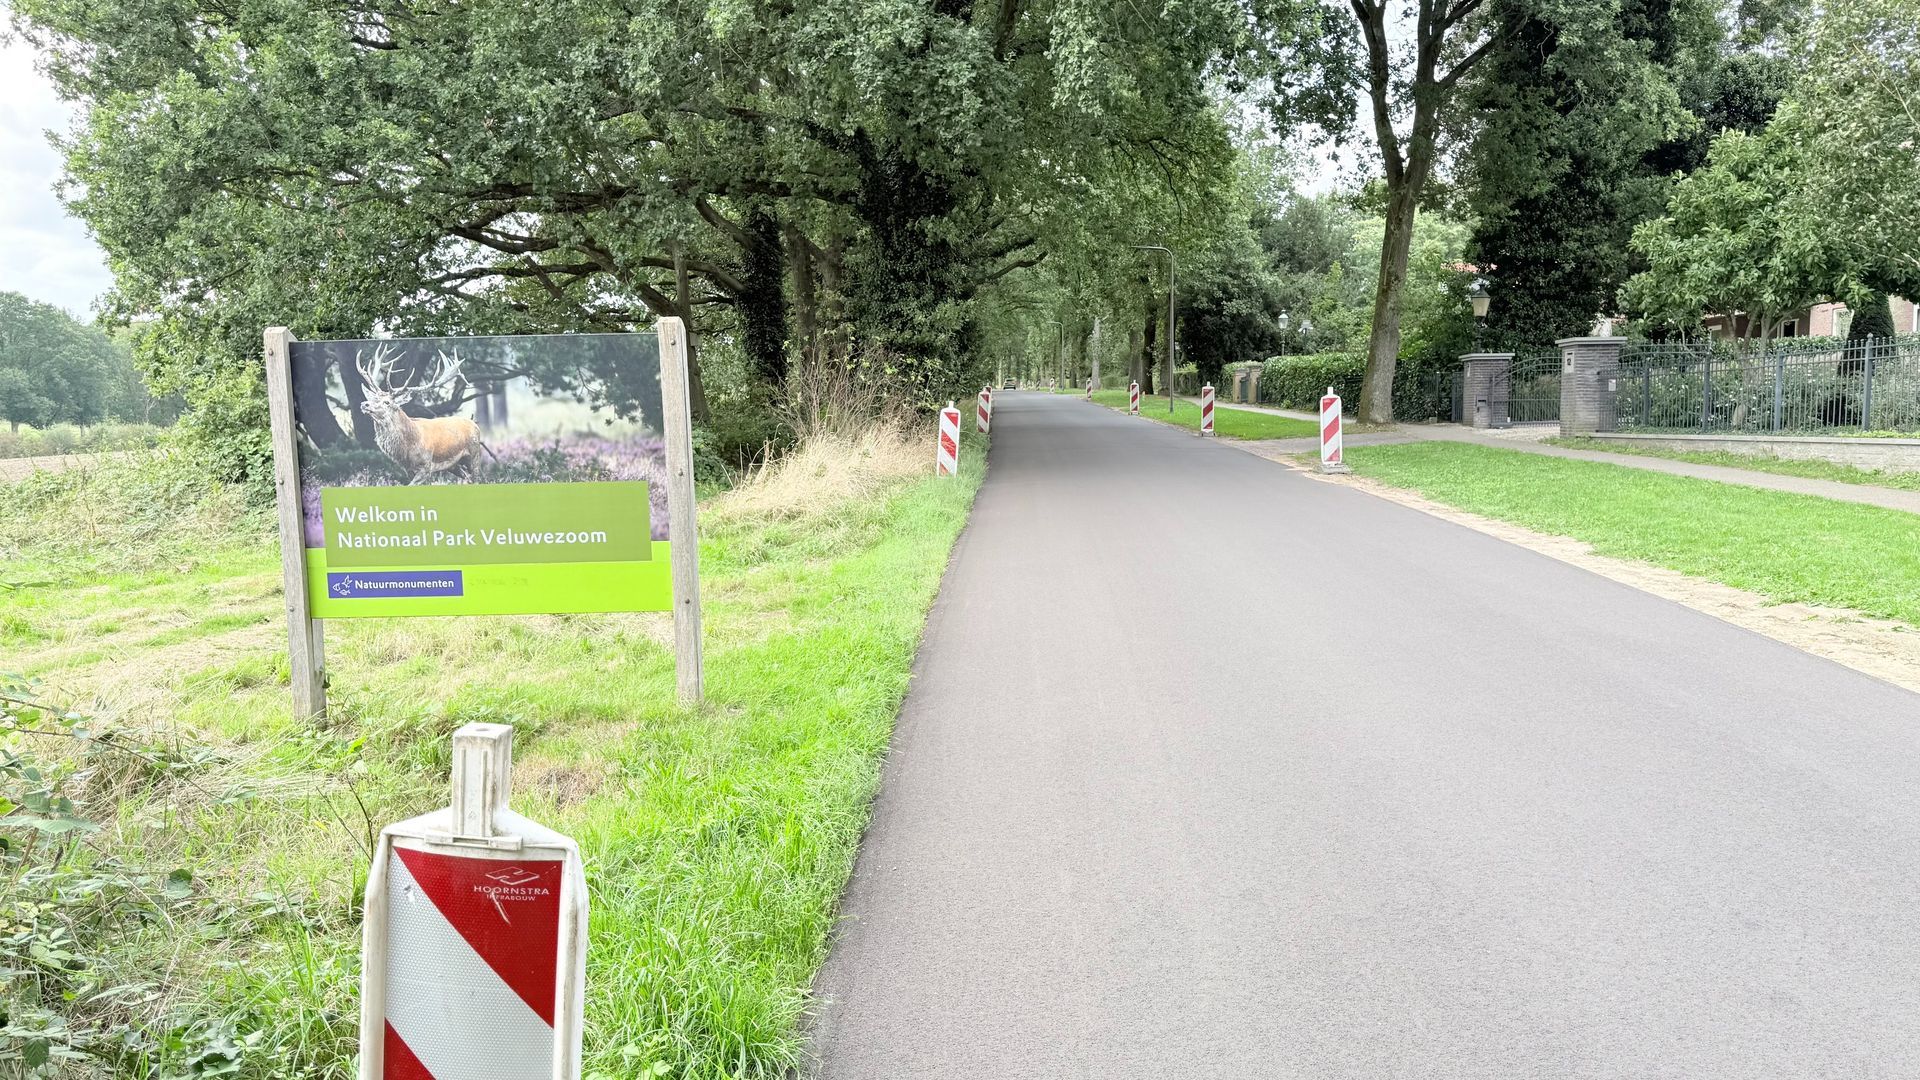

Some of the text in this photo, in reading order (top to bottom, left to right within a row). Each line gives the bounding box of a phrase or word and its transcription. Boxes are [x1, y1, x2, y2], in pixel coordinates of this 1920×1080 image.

[335, 505, 439, 524] Welkom in
[337, 527, 608, 549] Nationaal Park Veluwezoom
[354, 579, 455, 590] Natuurmonumenten
[473, 885, 550, 895] HOORNSTRA
